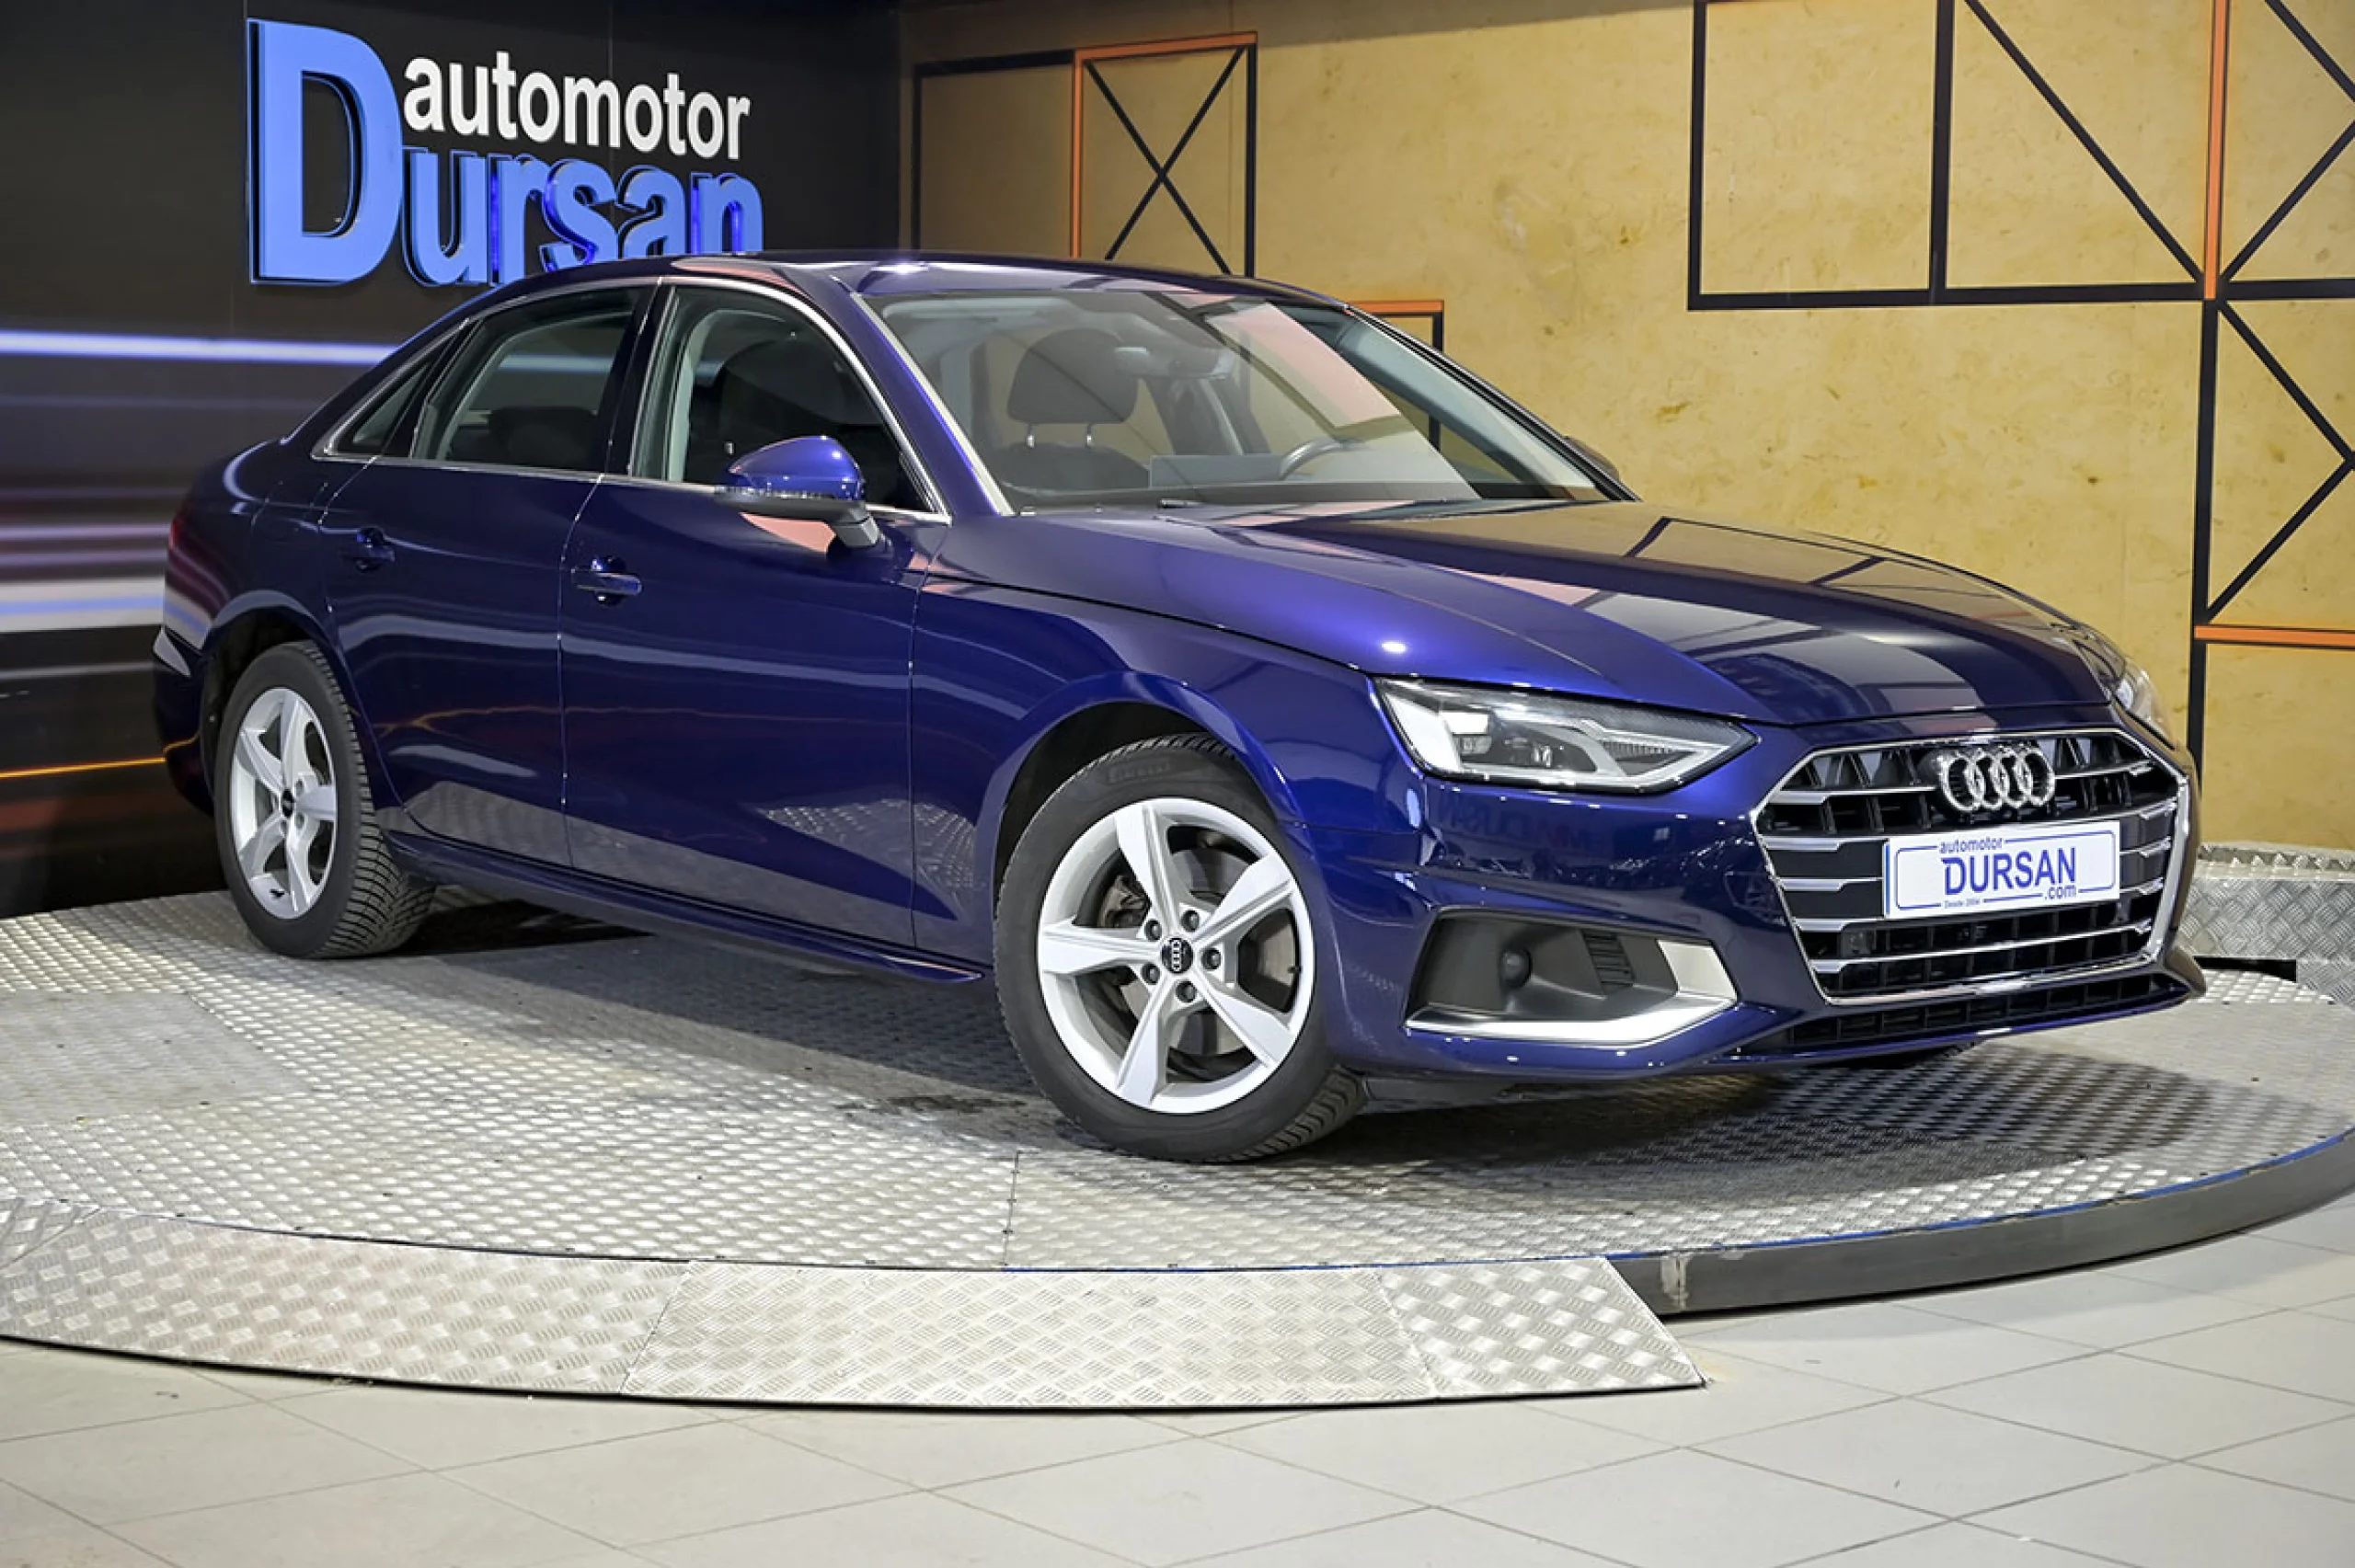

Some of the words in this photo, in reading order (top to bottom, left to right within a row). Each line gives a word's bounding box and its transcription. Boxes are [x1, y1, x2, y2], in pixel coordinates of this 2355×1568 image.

[404, 51, 750, 159] automotor
[247, 17, 764, 286] Dursan
[1940, 837, 2003, 854] automotor
[1941, 847, 2076, 896] DURSAN
[2044, 885, 2077, 901] .com
